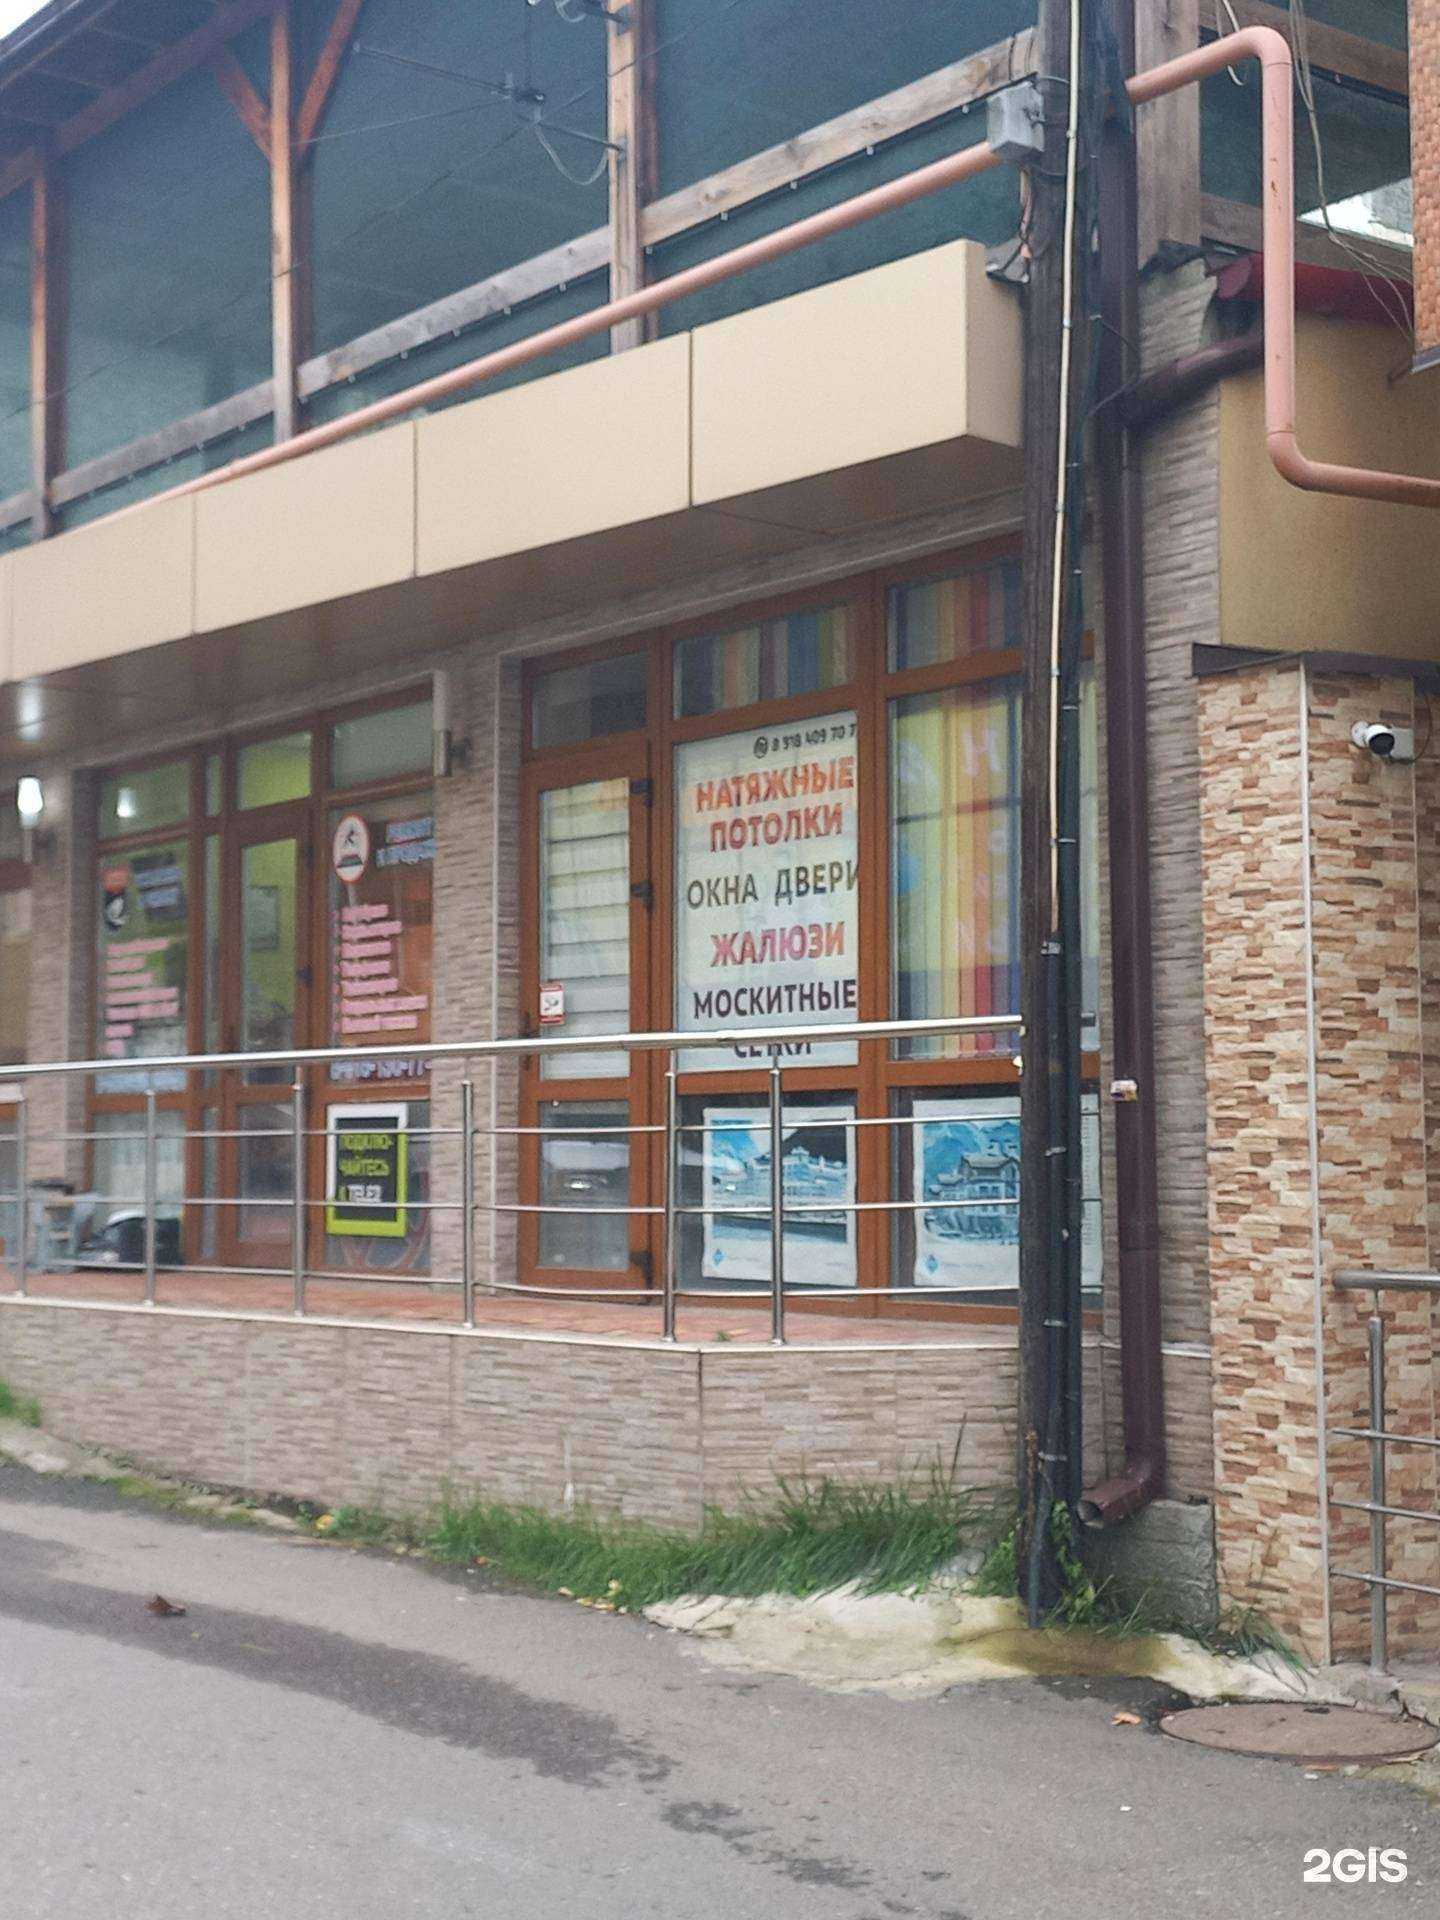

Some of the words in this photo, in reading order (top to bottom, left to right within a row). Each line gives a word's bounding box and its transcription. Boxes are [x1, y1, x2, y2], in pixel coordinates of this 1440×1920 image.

[805, 728, 827, 745] 409
[831, 724, 846, 741] 70
[696, 756, 855, 814] НАТЯЖНЫЕ
[710, 803, 843, 853] ПОТОЛКИ
[687, 873, 760, 909] ОКНА
[710, 921, 846, 968] ЖАЛЮЗИ
[693, 979, 857, 1019] МОСКИТНЫЕ
